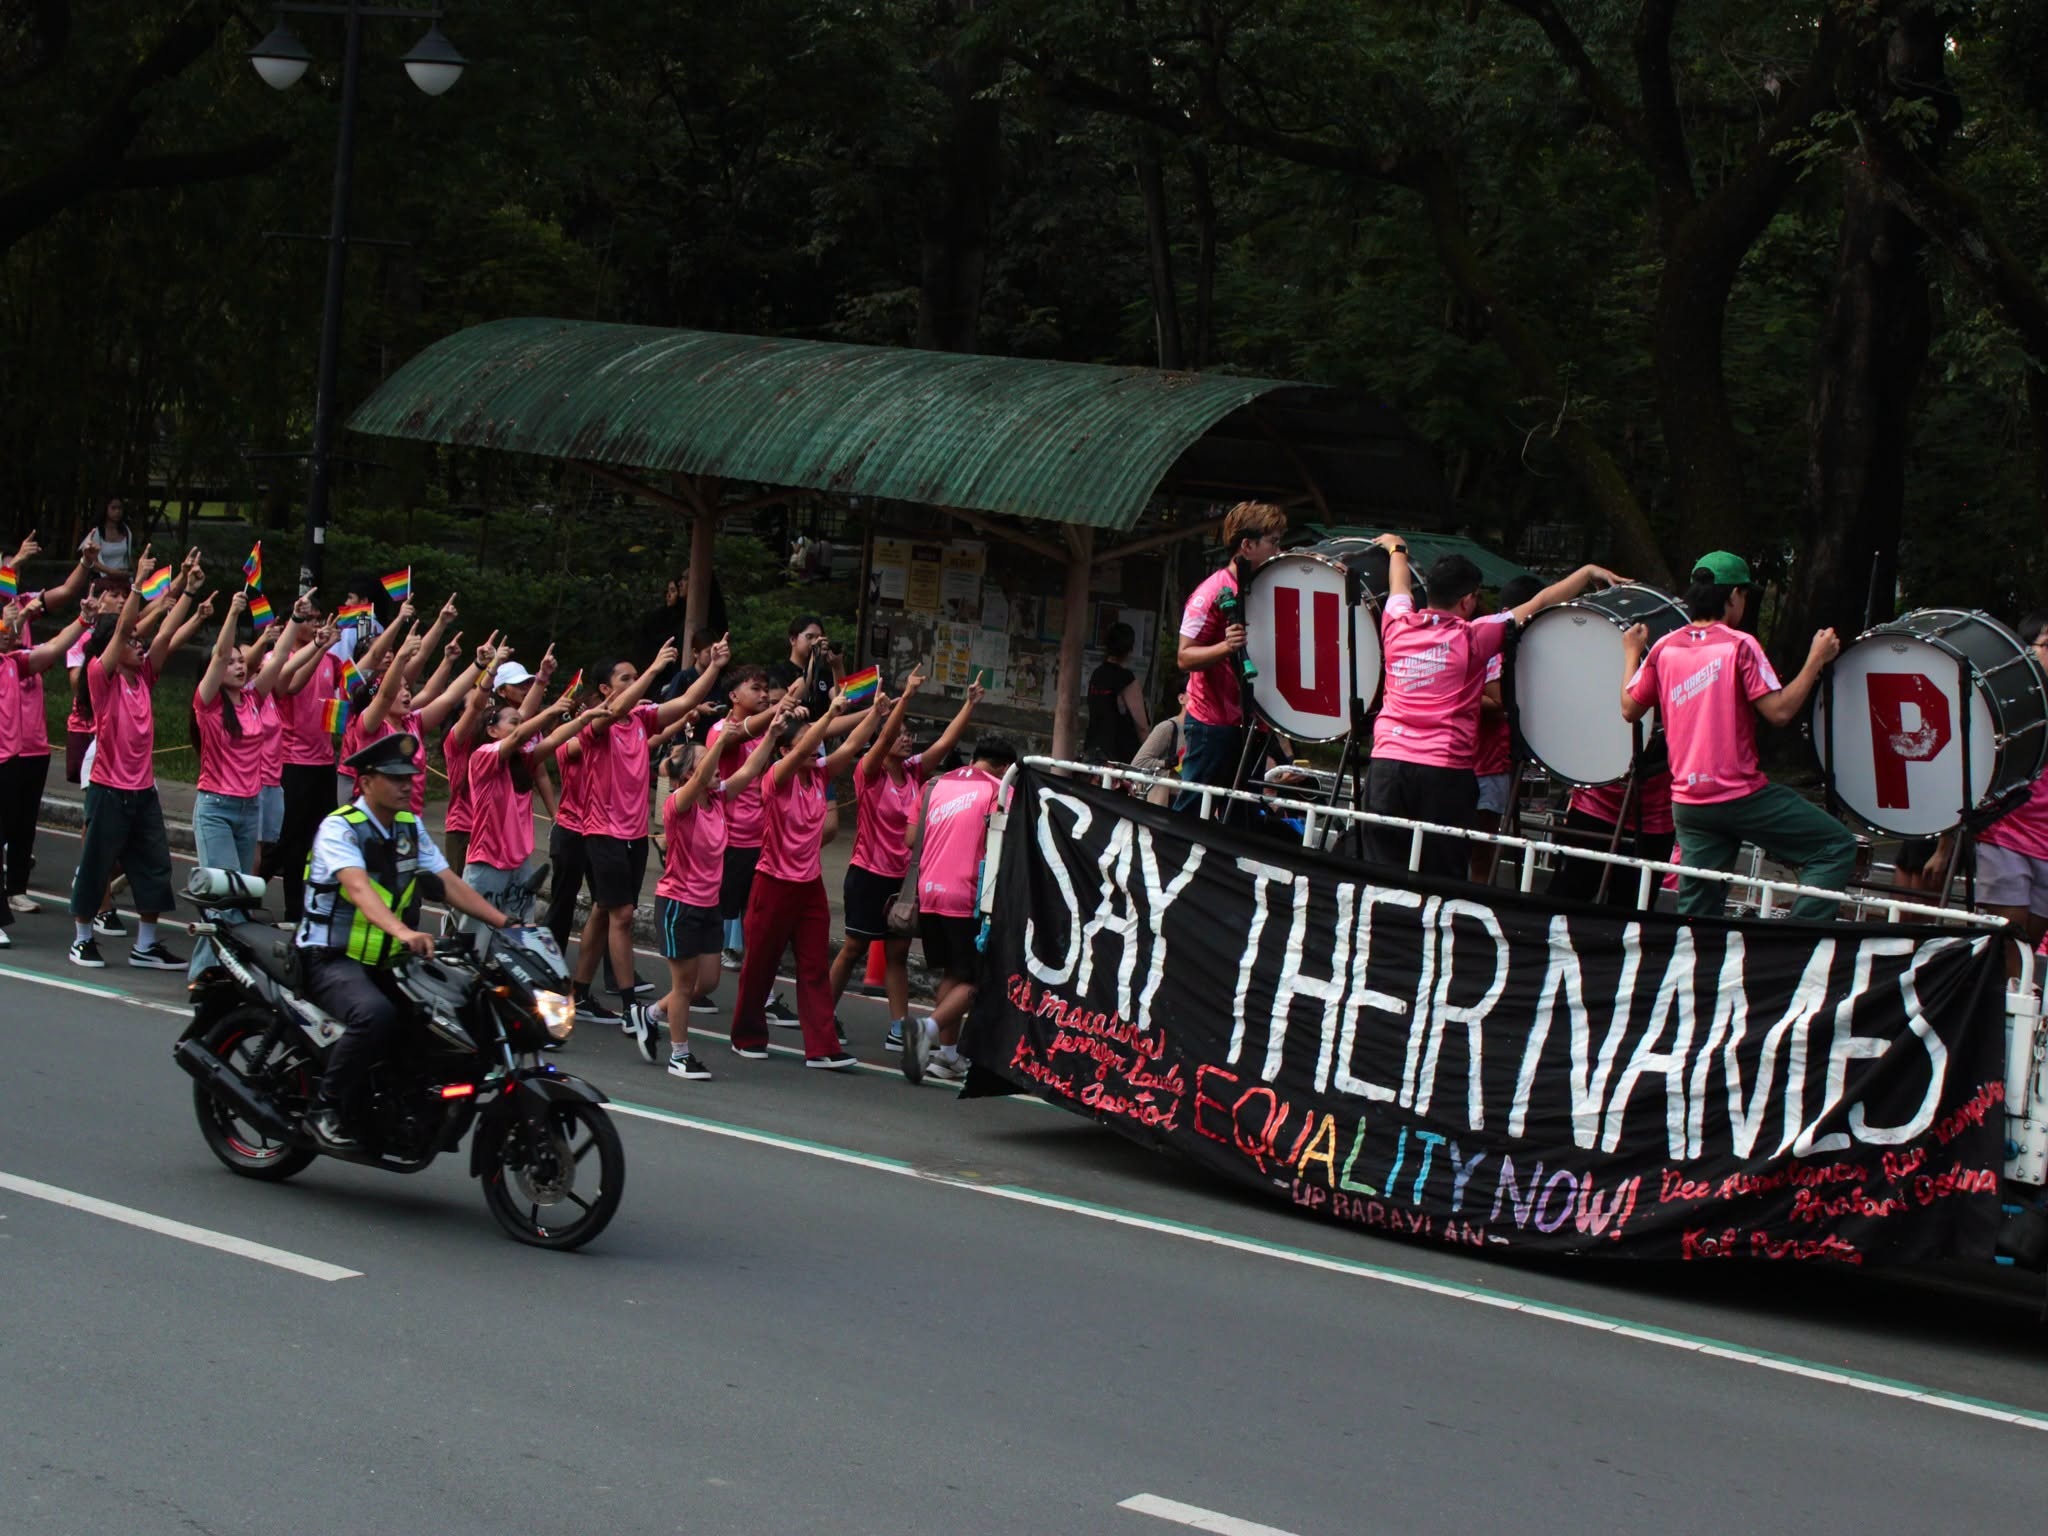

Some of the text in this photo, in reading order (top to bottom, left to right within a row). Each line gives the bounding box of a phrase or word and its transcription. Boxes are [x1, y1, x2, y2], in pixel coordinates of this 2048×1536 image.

[1274, 586, 1341, 718] U
[1671, 656, 1722, 702] UP VARSITY
[1866, 673, 1952, 809] P
[1025, 787, 1993, 1161] SAY THEIR NAMES
[1194, 1063, 1642, 1241] EQUALITY NOW!
